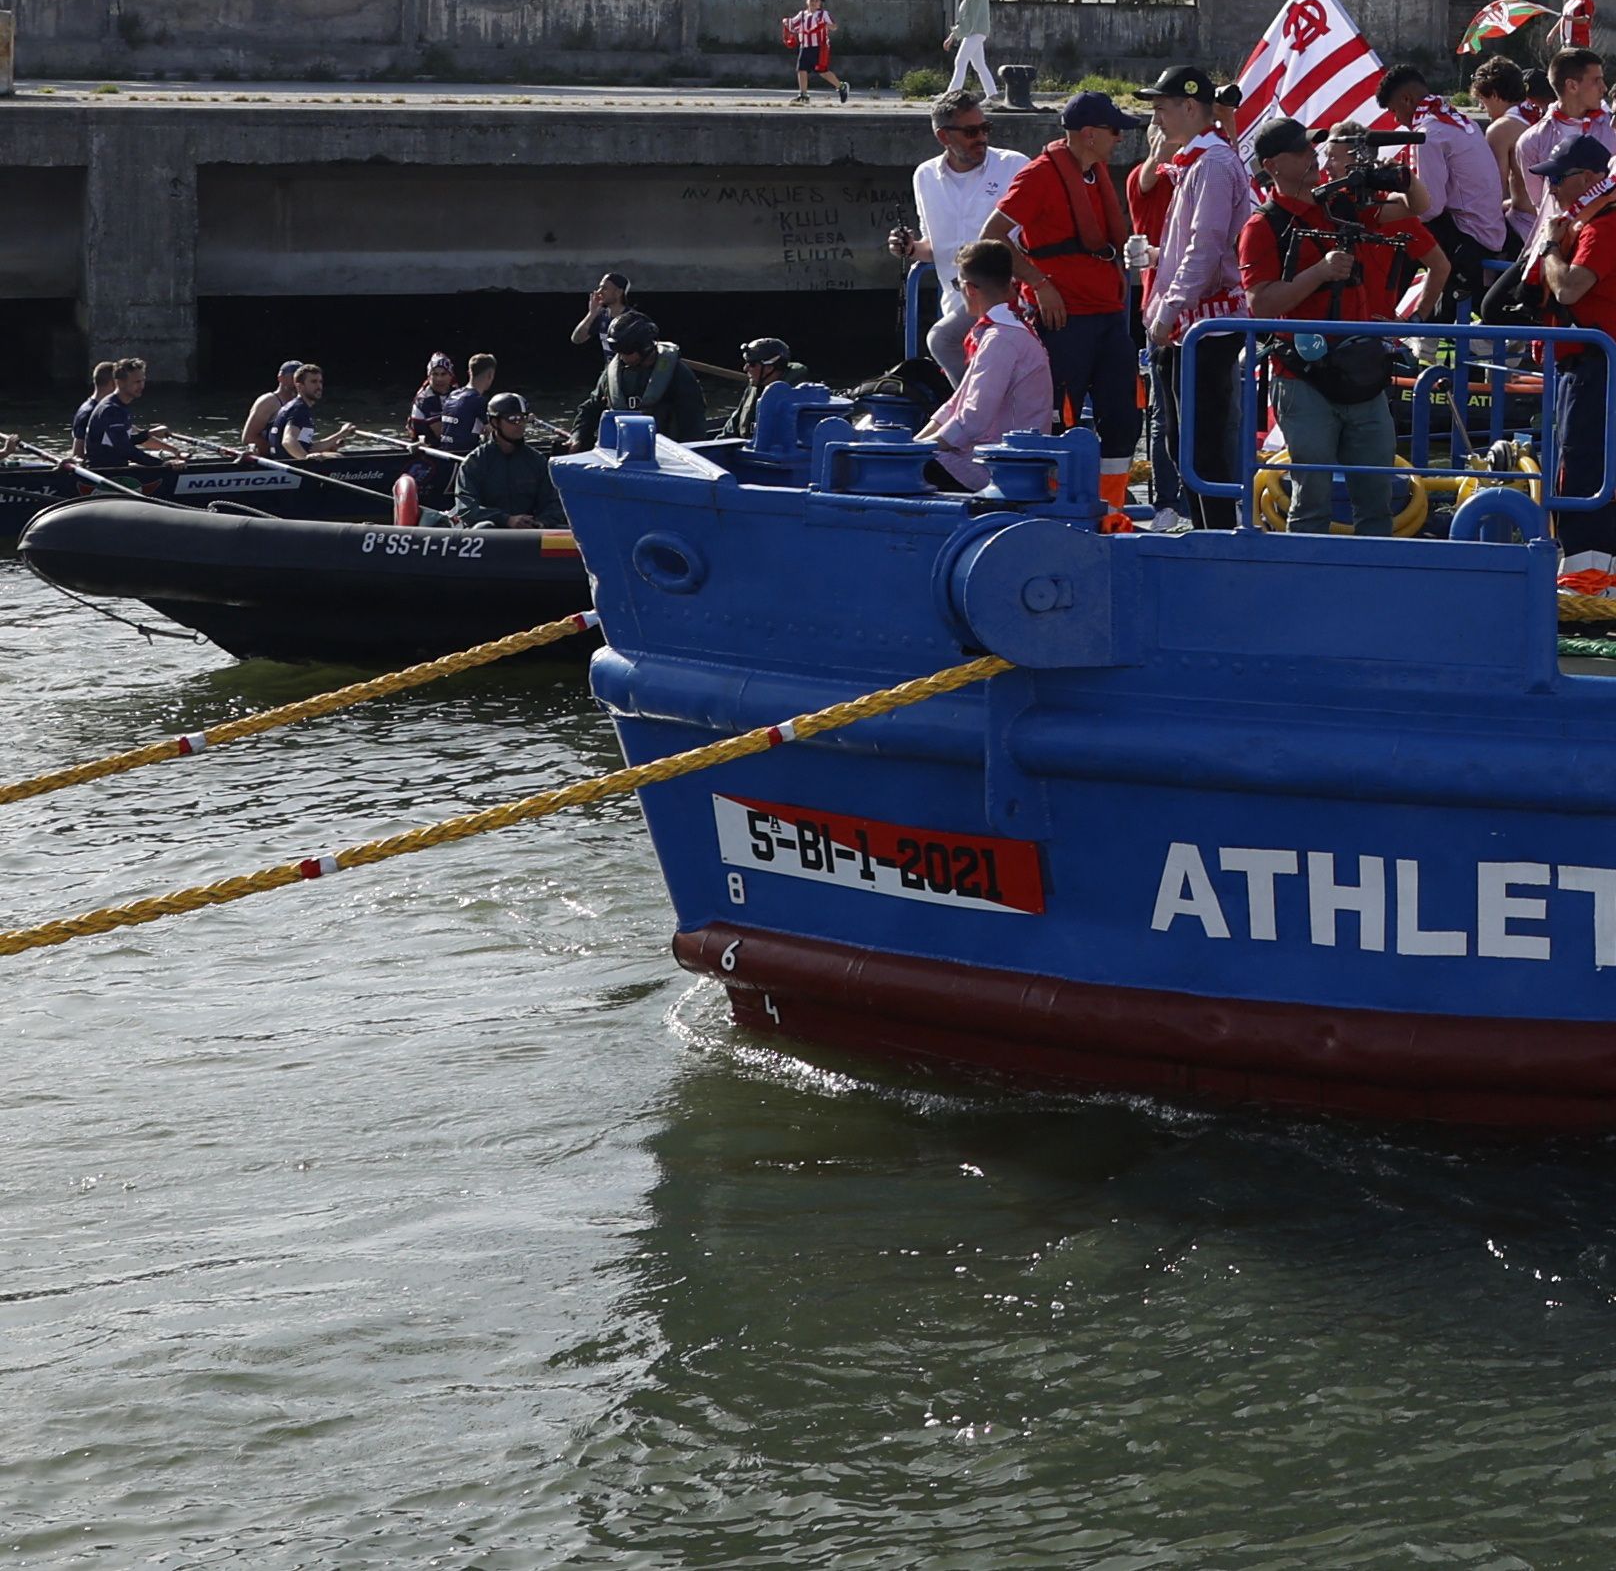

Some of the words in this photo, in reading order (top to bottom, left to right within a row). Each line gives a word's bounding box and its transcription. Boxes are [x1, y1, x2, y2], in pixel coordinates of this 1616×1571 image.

[779, 208, 840, 231] KULU
[186, 473, 292, 490] NAUTICAL
[726, 872, 745, 905] 8
[720, 939, 742, 971] 6
[763, 994, 781, 1025] 4
